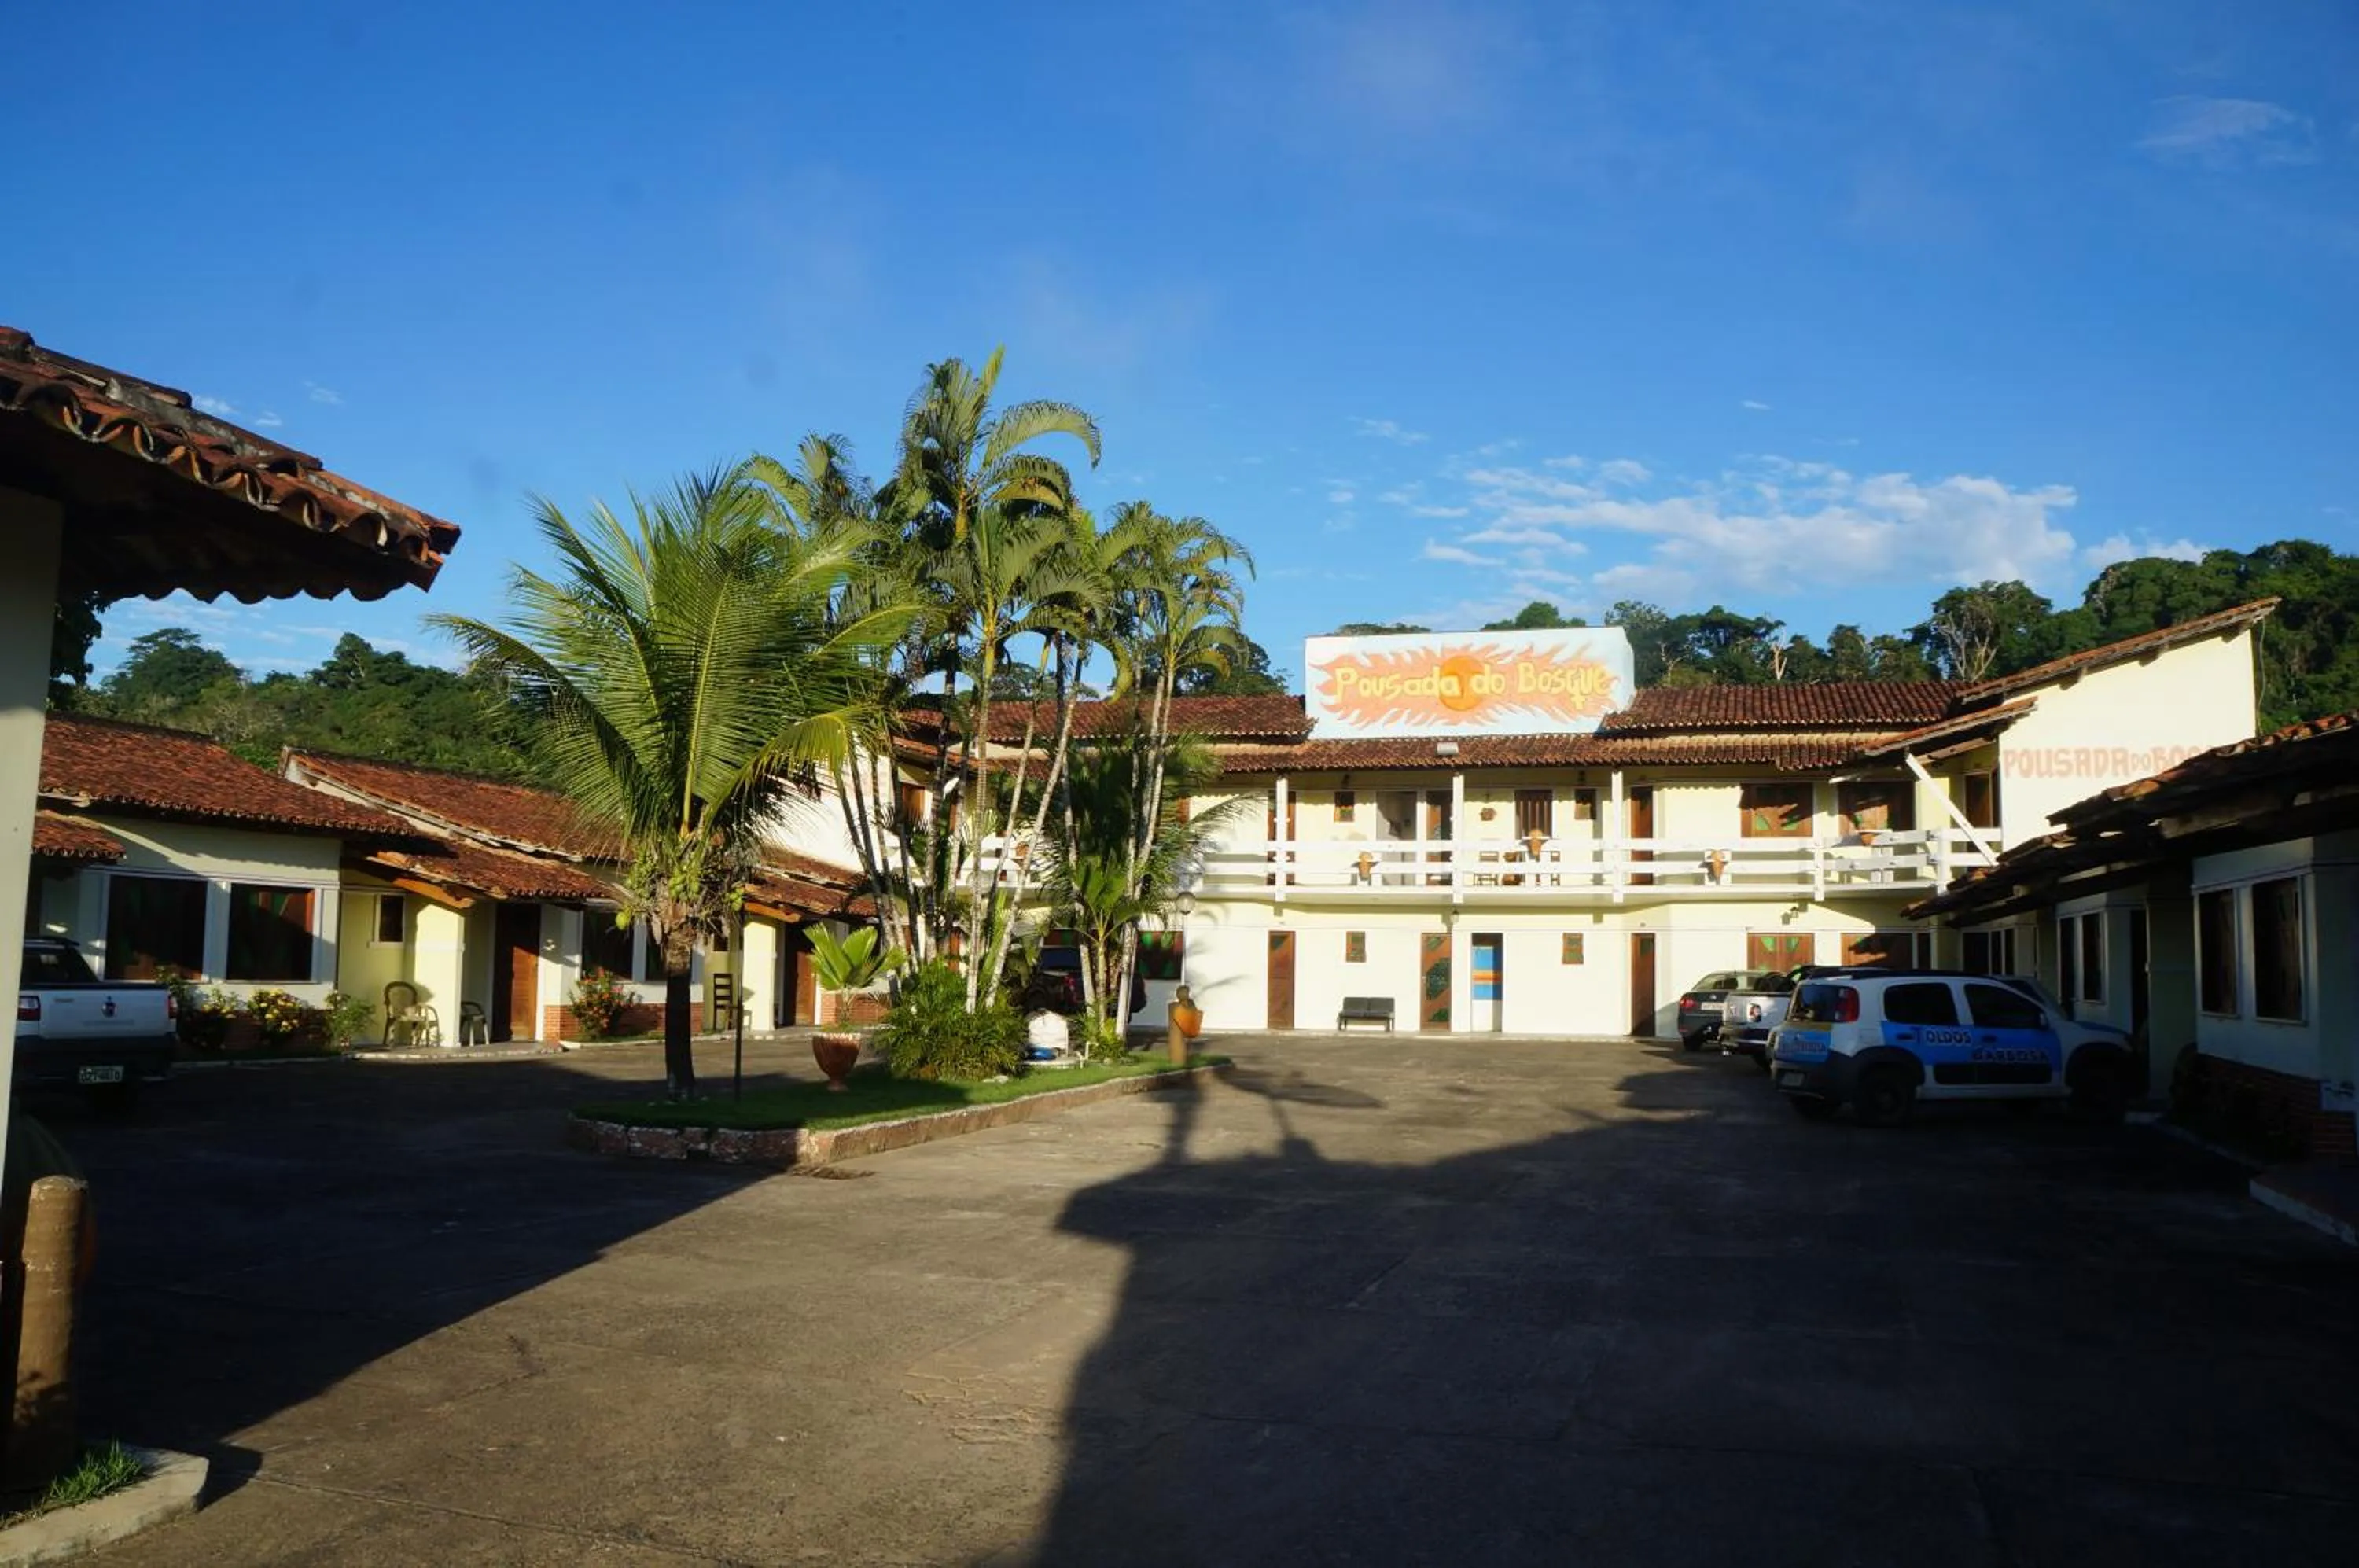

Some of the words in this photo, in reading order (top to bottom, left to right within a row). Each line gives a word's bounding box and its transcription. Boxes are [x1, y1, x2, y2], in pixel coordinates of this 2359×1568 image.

[1335, 665, 1461, 702] Pousada
[1471, 664, 1505, 695] do
[1516, 661, 1611, 710] Bosque
[2003, 747, 2129, 778] POUSADA
[2131, 752, 2151, 772] DO
